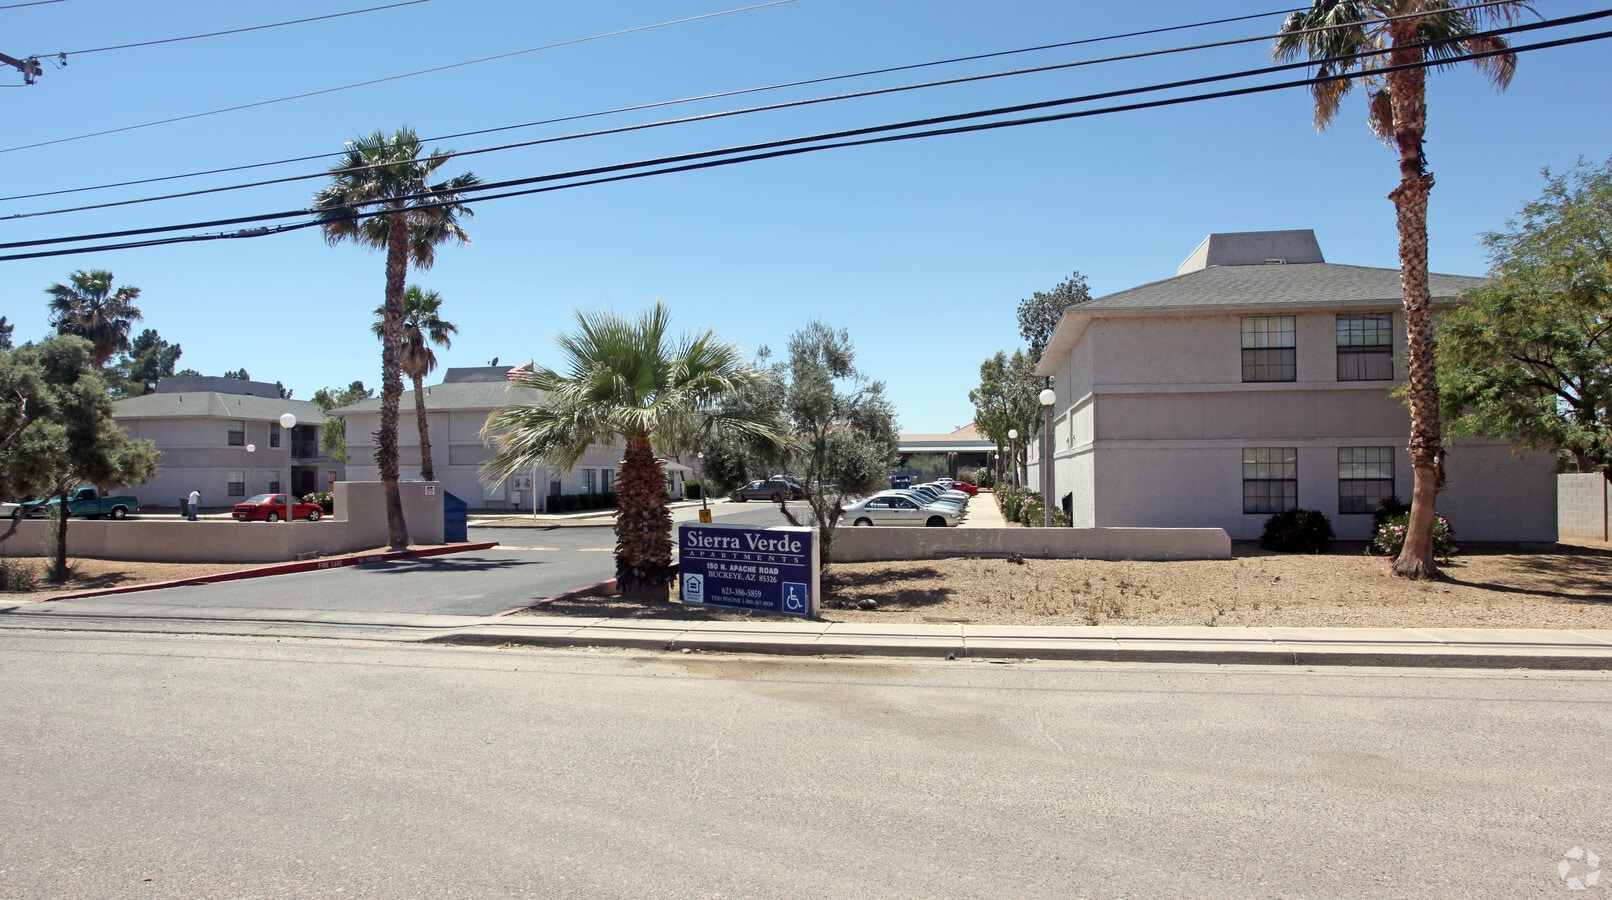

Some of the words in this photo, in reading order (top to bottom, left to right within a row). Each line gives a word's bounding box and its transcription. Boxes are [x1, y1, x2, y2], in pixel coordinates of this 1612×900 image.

[687, 530, 740, 549] Sierra
[744, 533, 802, 553] Verde
[689, 550, 799, 563] APARTMENTS
[706, 562, 718, 570] 150
[720, 563, 727, 571] N.
[729, 564, 757, 573] APACHE
[759, 566, 779, 575] ROAD
[708, 570, 744, 581] BUCKEYE,
[745, 574, 756, 582] AZ
[759, 575, 778, 583] 85326
[721, 587, 762, 598] 623-386-5859
[723, 596, 742, 604] PHONE
